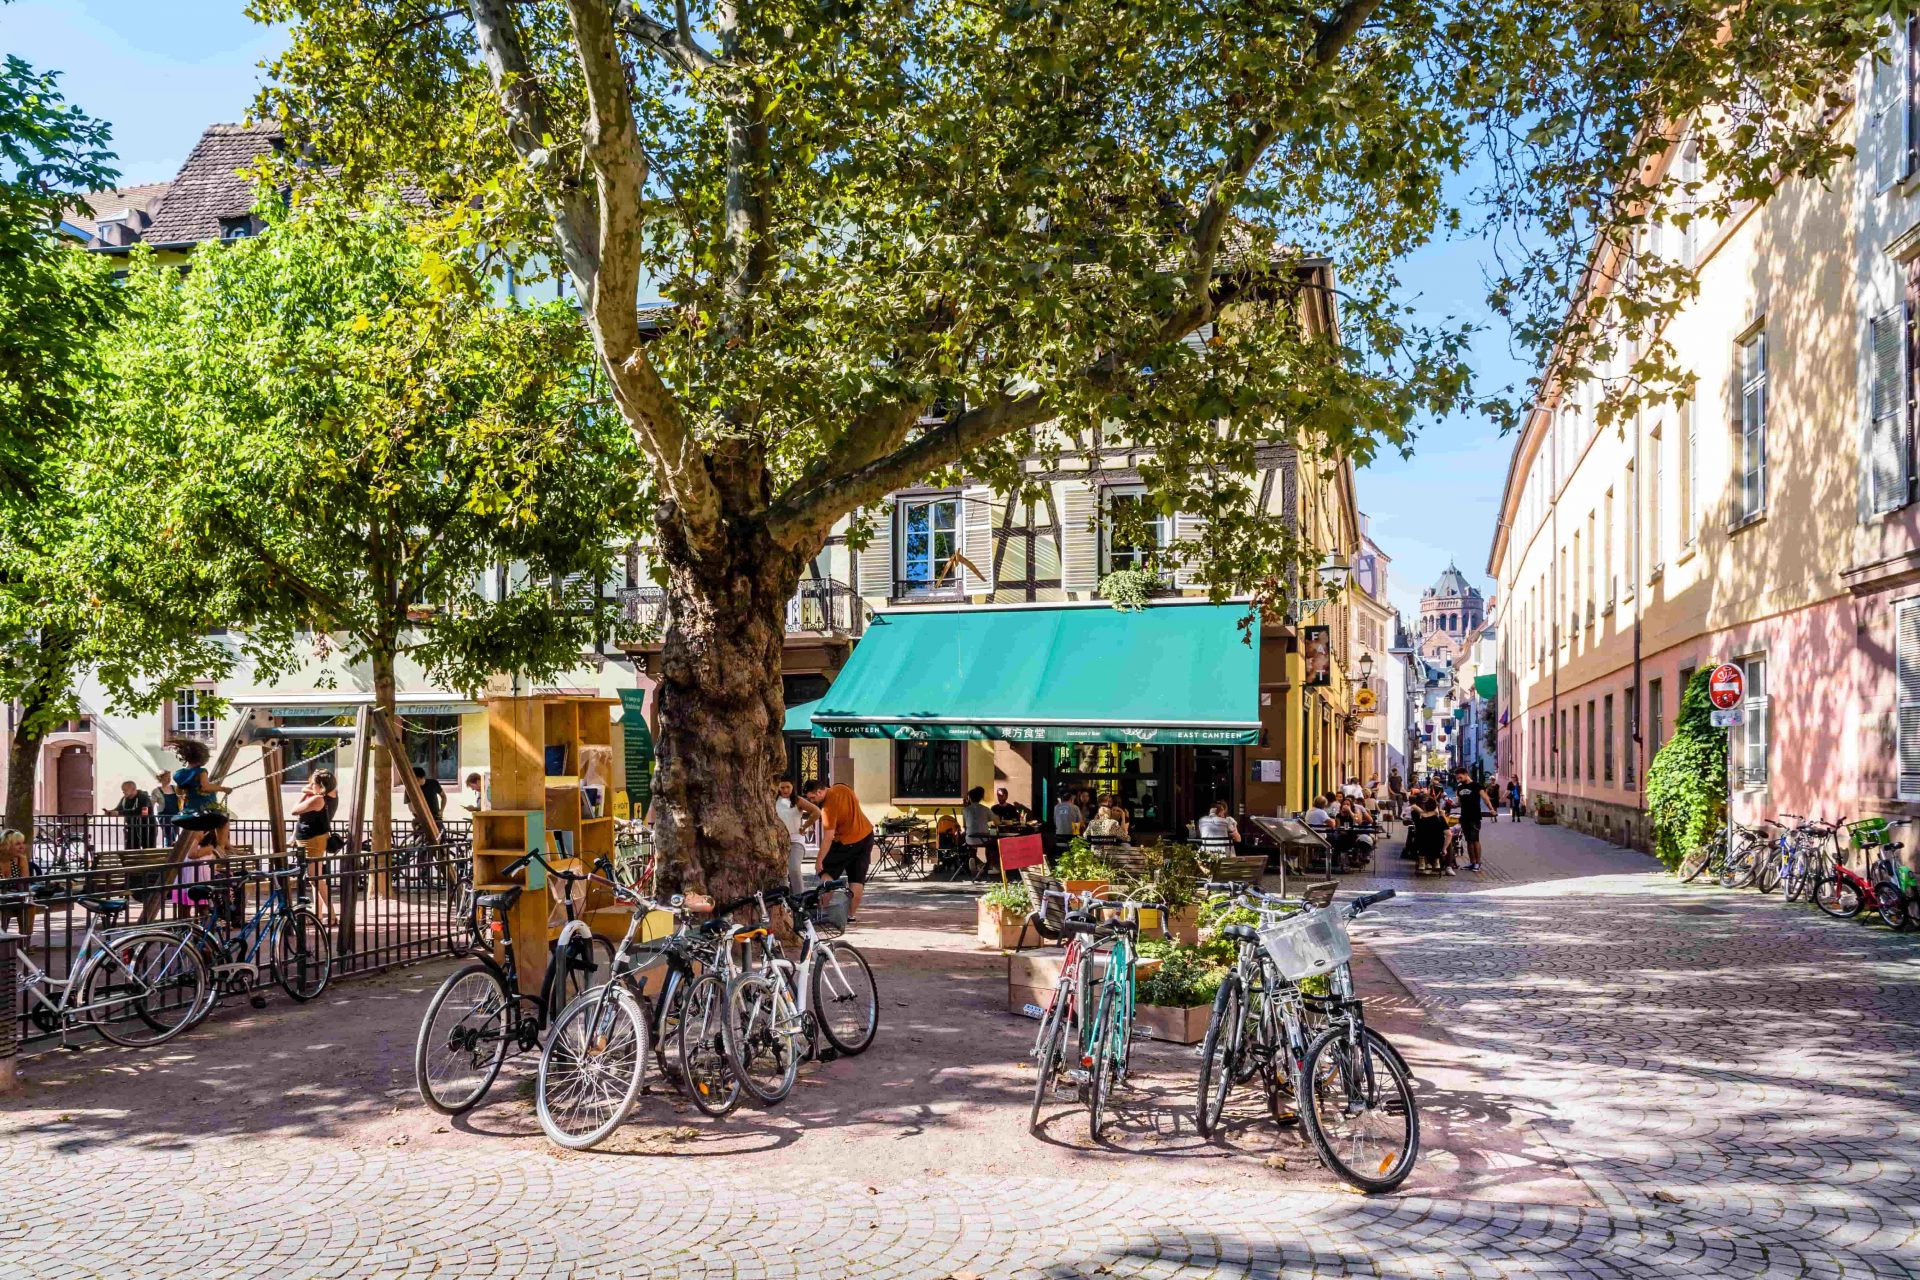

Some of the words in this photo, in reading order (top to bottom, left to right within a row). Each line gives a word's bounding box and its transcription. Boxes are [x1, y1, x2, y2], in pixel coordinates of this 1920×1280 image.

[272, 706, 321, 716] estaurant
[1001, 727, 1046, 739] 東方食堂
